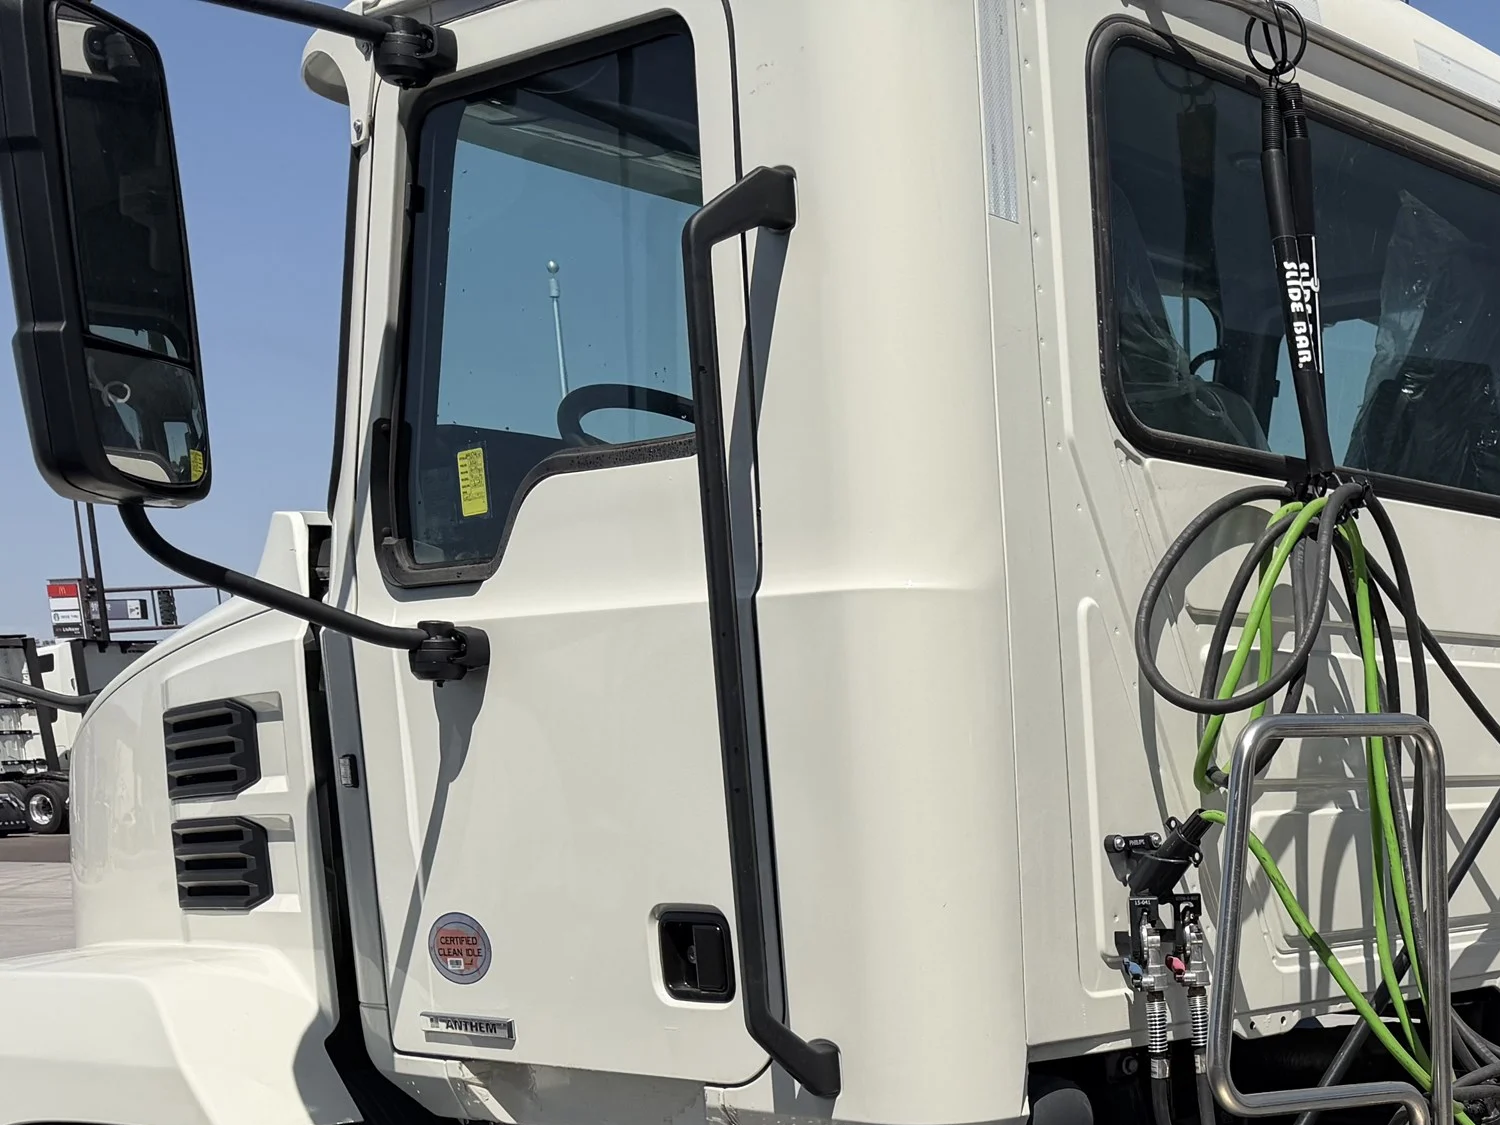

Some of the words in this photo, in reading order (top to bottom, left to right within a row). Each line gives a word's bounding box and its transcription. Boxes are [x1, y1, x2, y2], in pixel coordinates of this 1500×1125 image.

[1283, 261, 1305, 313] SLIDE
[1293, 321, 1312, 363] BAR
[439, 936, 478, 946] CERTIFIED
[437, 948, 463, 957] CLEAN
[465, 948, 482, 957] IDLE
[445, 1019, 497, 1034] ANTHEM
